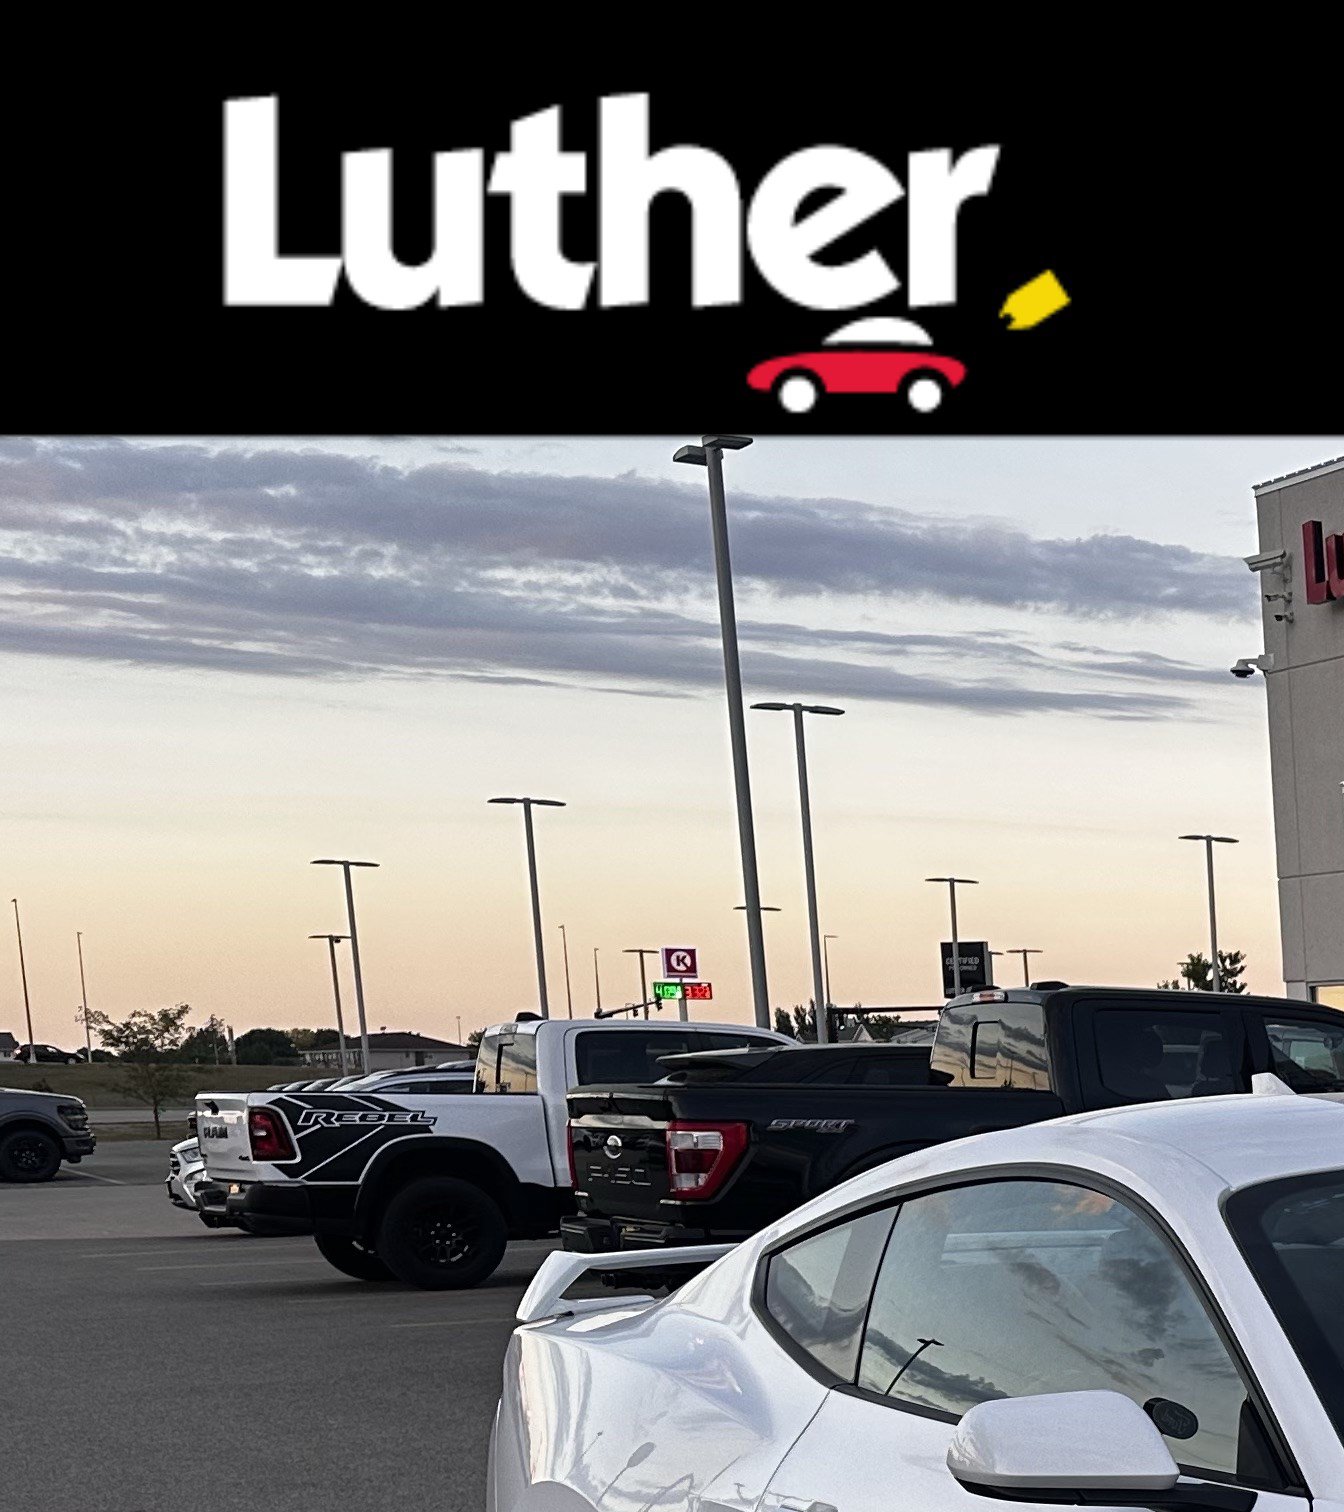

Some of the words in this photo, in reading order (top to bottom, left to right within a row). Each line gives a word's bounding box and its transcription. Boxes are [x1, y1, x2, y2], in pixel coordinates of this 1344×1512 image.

[297, 1109, 438, 1128] REBEL
[766, 1118, 856, 1132] SPORT
[203, 1125, 229, 1139] RAM
